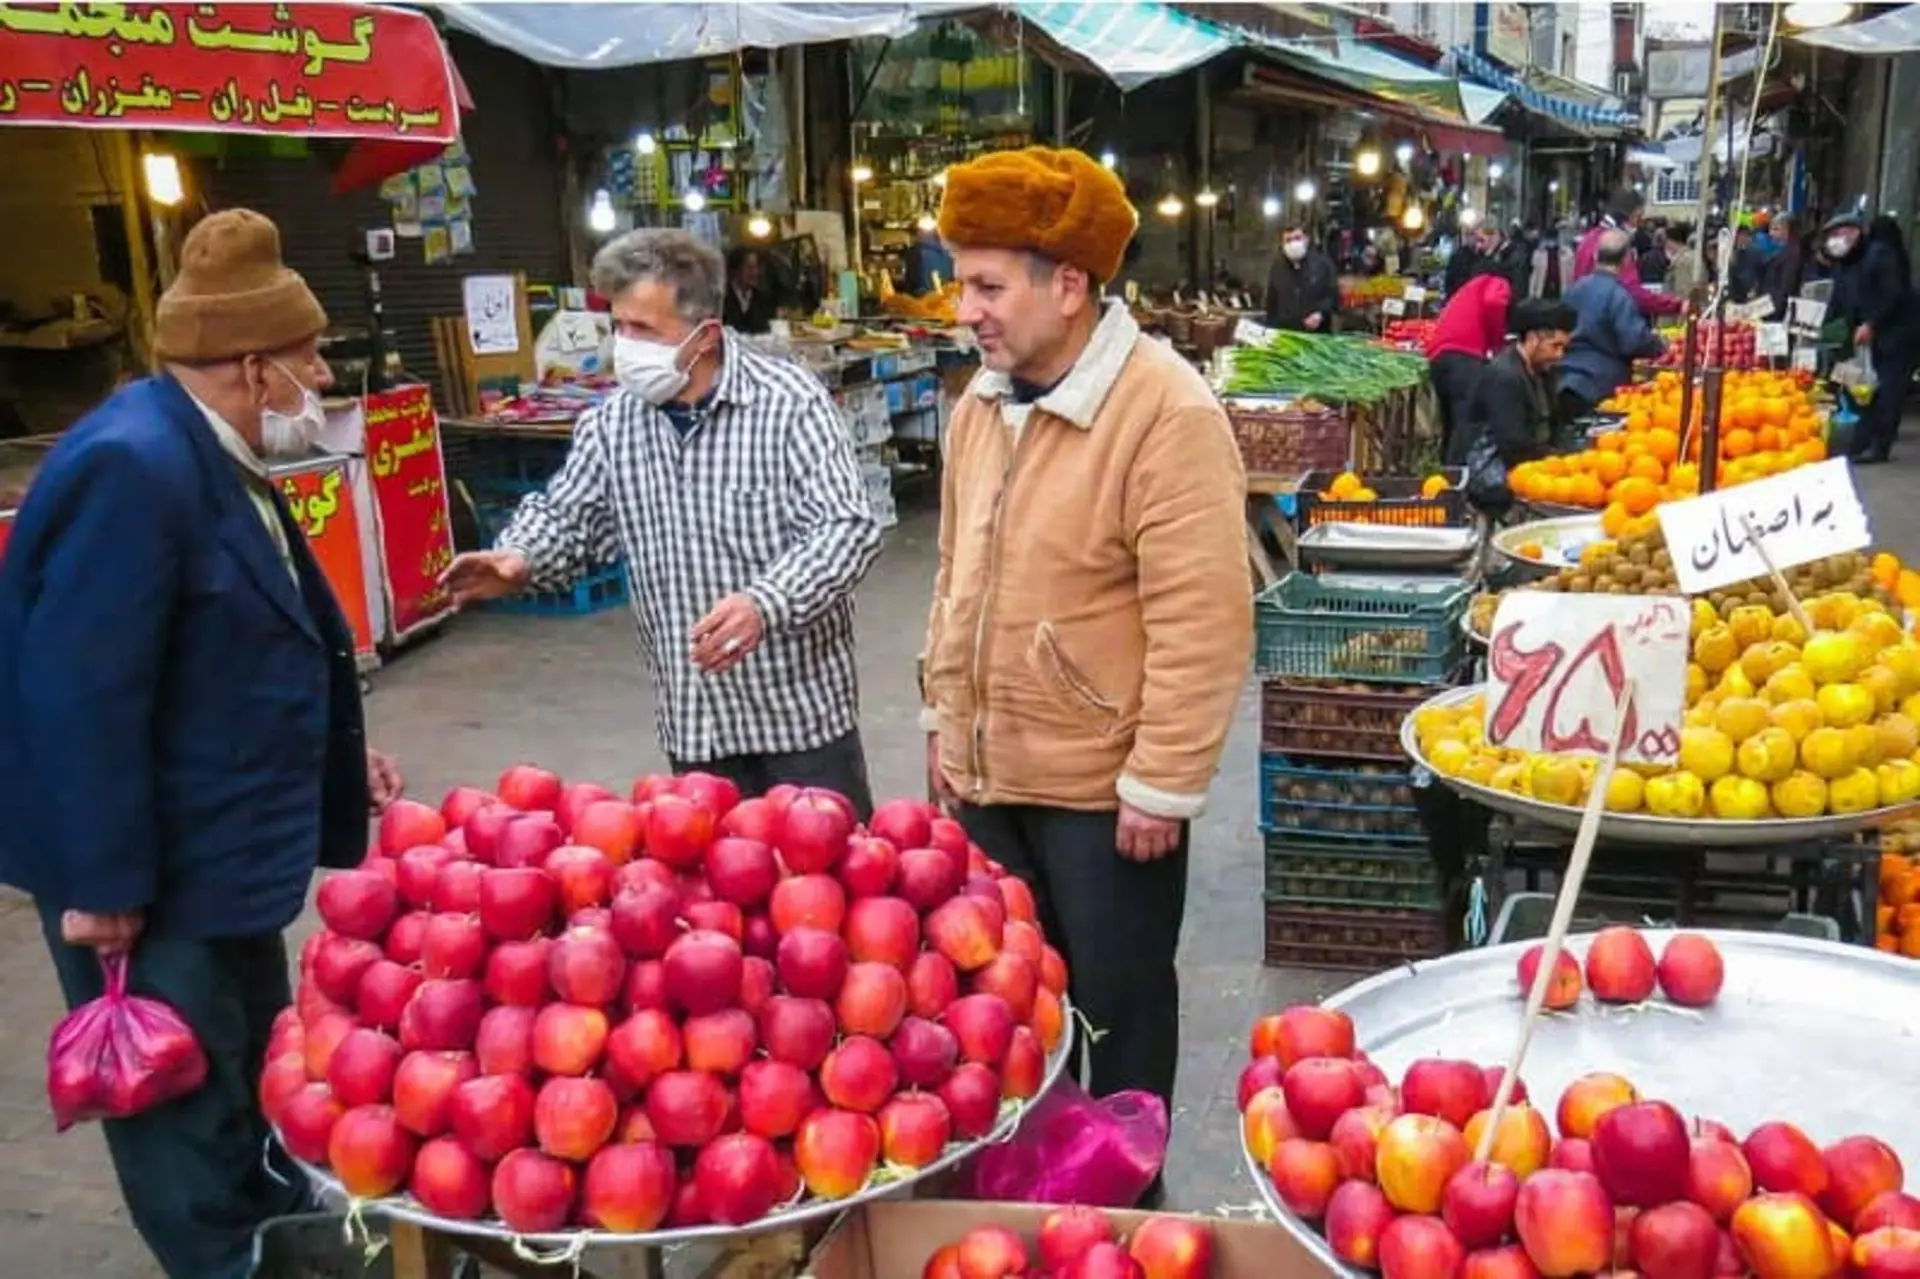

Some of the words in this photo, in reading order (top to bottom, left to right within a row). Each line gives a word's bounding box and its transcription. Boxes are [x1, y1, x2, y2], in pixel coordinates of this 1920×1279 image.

[0, 3, 175, 57] منجم
[187, 3, 375, 75] گوشت
[347, 96, 441, 132] سردست
[282, 470, 342, 536] گوش
